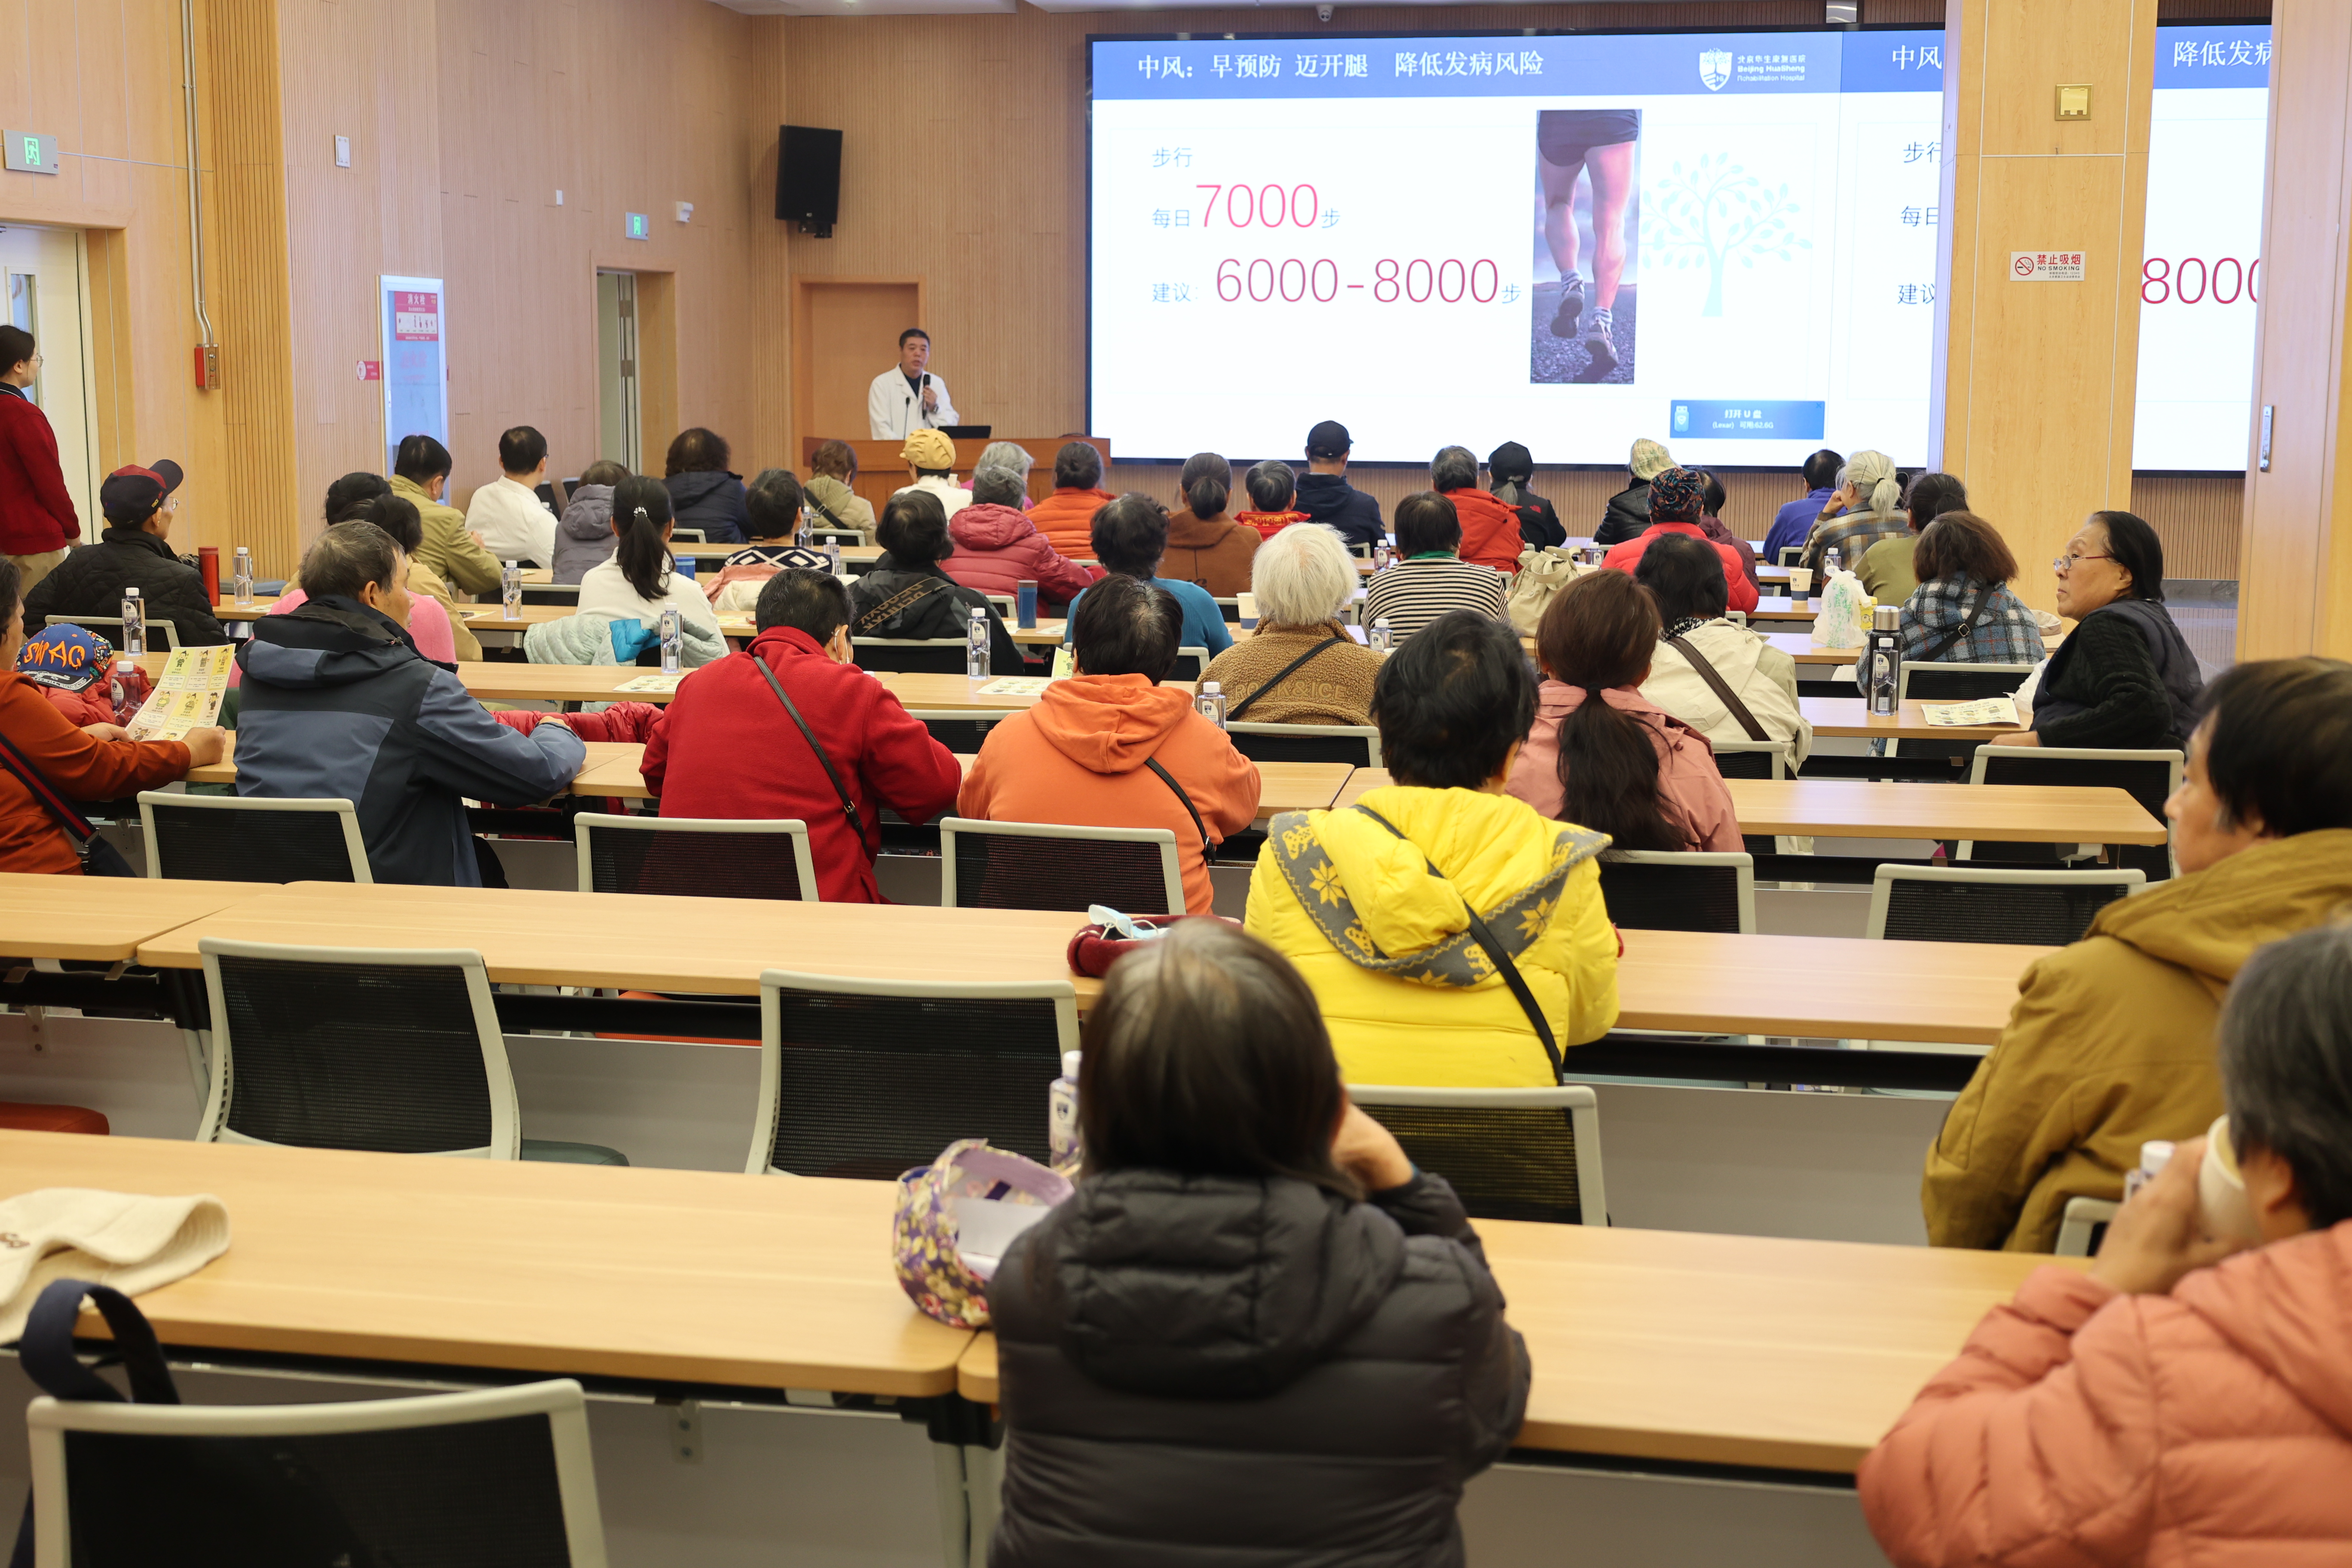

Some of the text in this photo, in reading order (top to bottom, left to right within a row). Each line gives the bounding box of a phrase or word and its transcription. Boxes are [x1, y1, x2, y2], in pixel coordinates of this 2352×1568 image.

[1138, 50, 1544, 79] 中风：早预防 迈开腿 降低发病风险
[1737, 55, 1806, 63] 北京华生康复医院
[1892, 45, 1942, 70] 中风
[1766, 65, 1805, 73] HuaSheng
[1152, 147, 1193, 168] 步行
[1152, 184, 1341, 228] 每日 7000 步
[2037, 254, 2081, 265] 禁止吸烟
[1501, 284, 1522, 303] 步
[1724, 409, 1741, 419] 打开
[1744, 410, 1751, 418] U
[23, 640, 85, 671] SWAG
